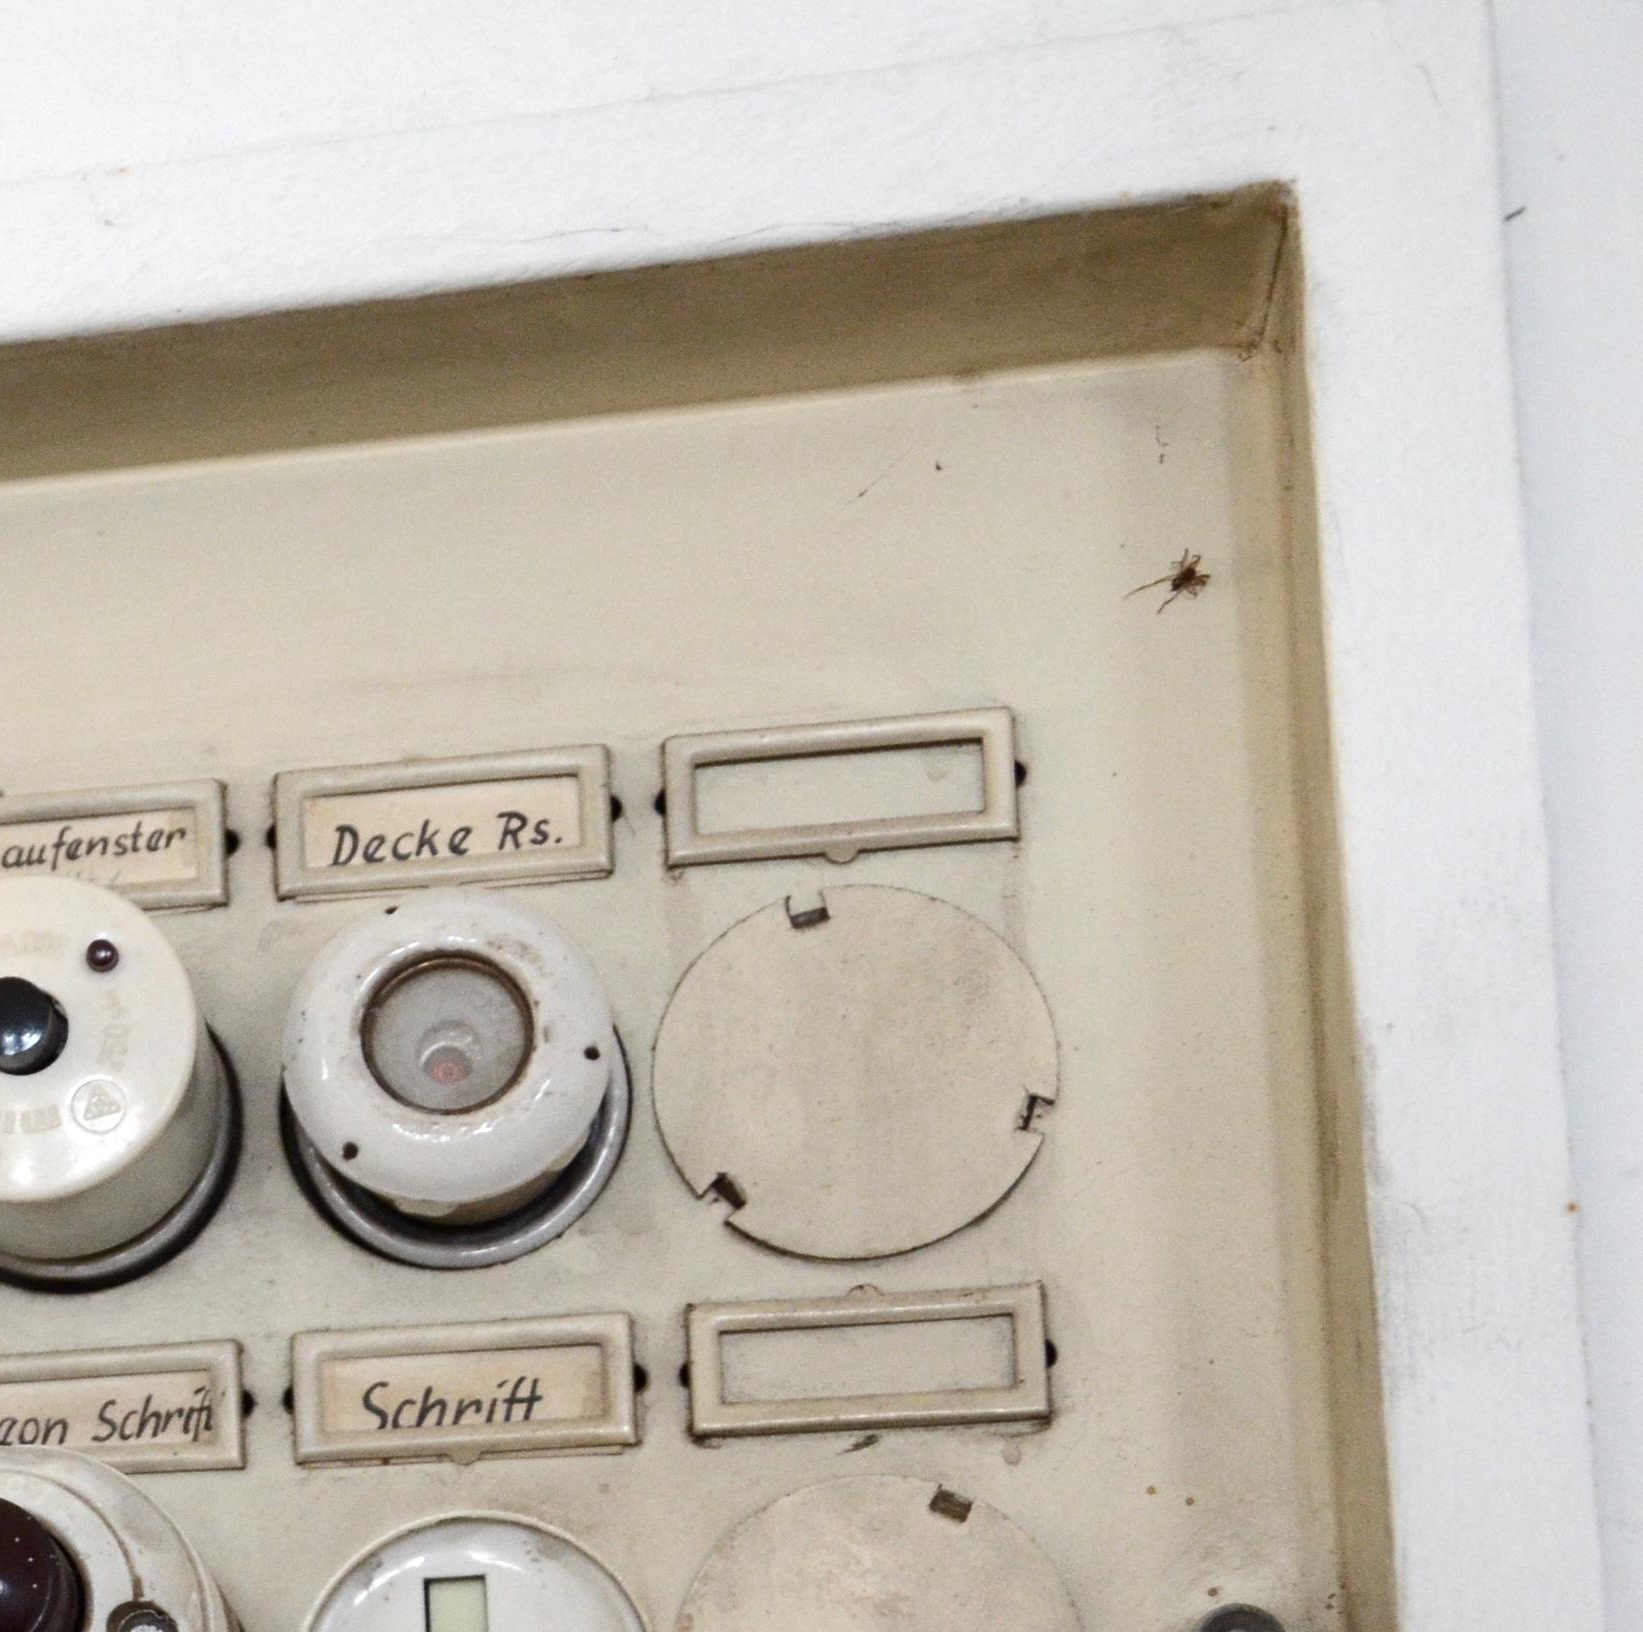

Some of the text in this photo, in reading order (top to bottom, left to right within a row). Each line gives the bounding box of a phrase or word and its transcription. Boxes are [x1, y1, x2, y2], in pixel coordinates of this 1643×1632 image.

[330, 810, 563, 867] Decke Rs.
[361, 1375, 544, 1431] Schrift
